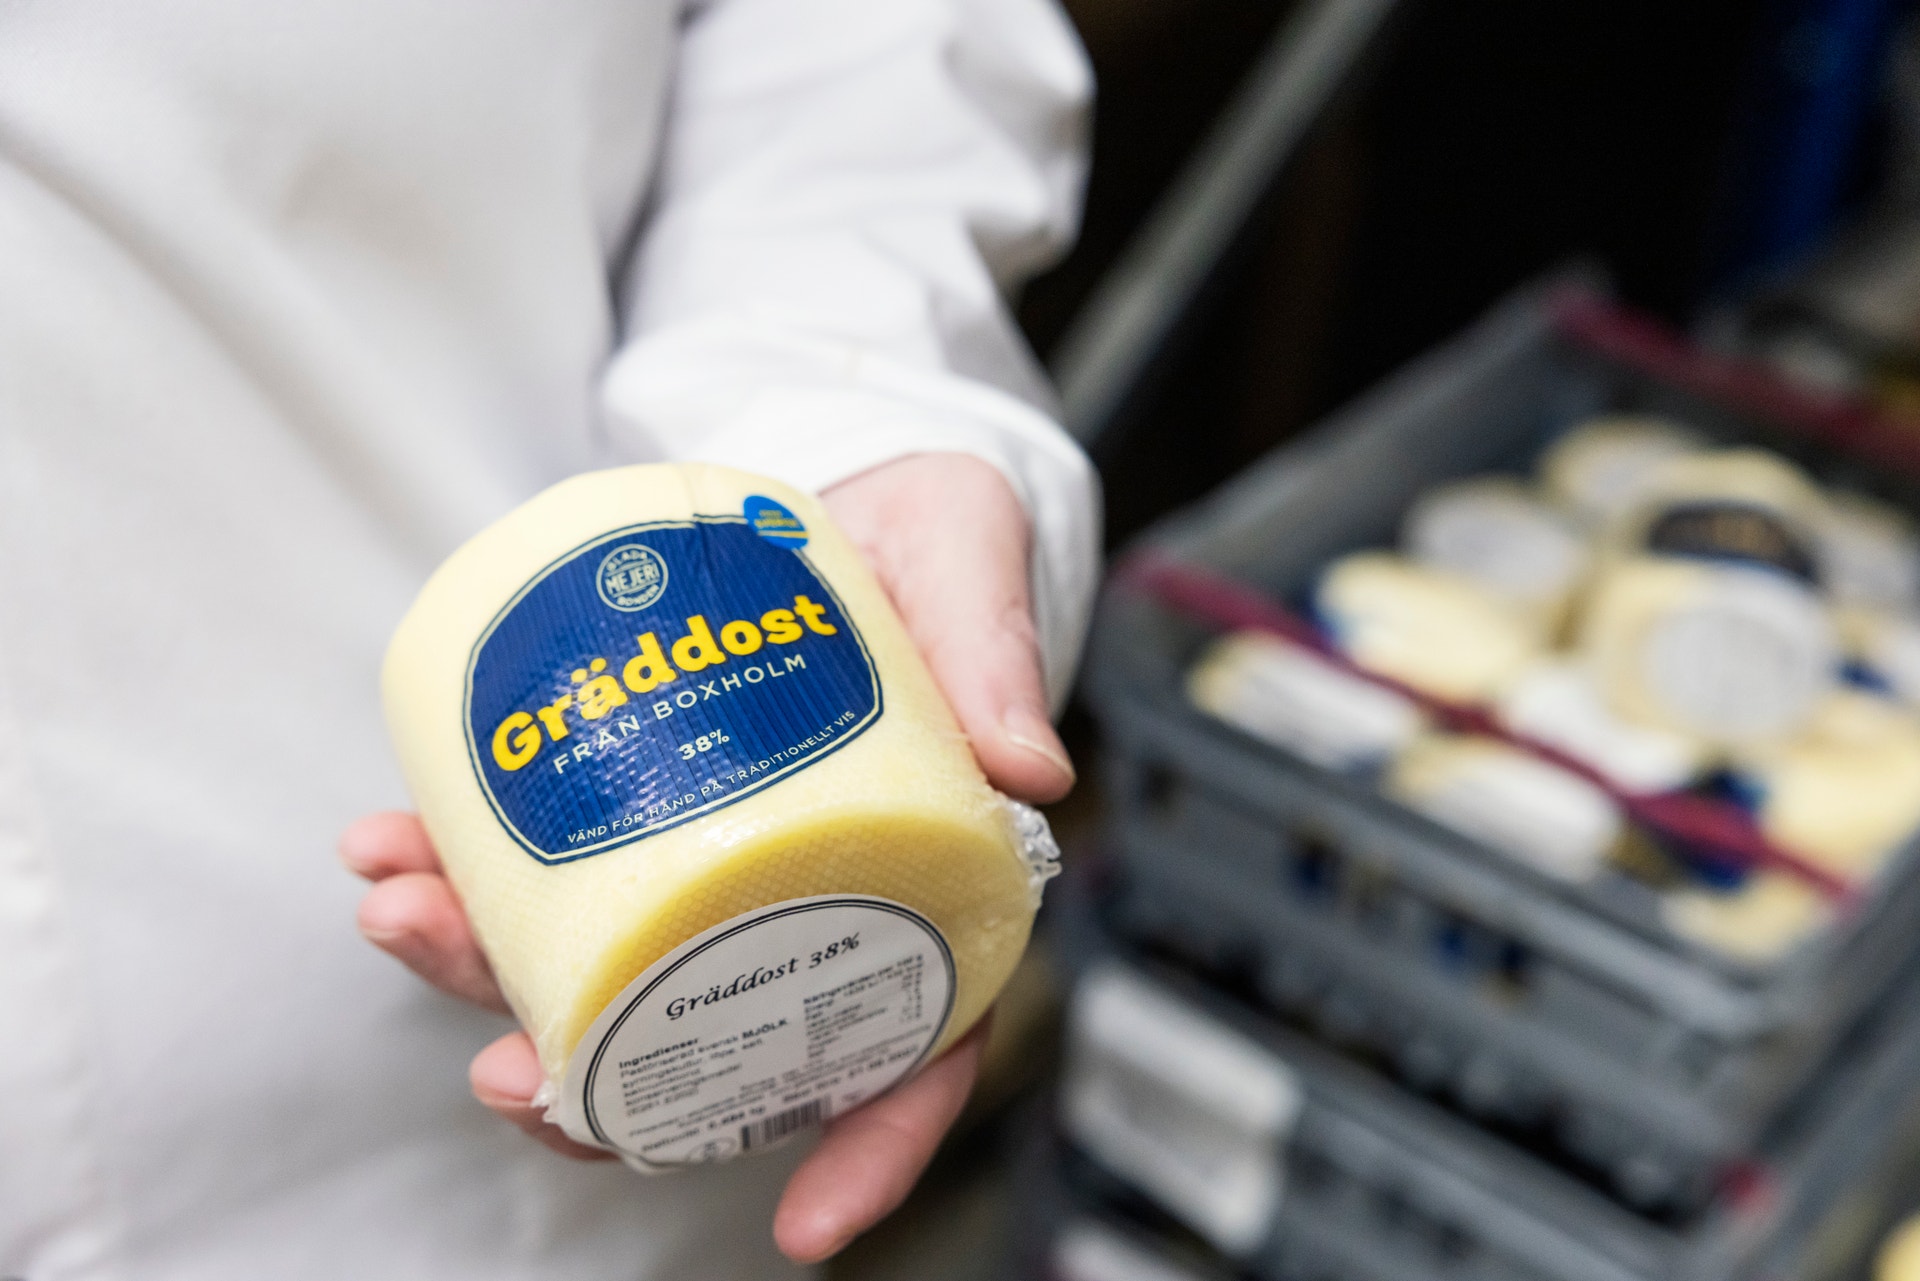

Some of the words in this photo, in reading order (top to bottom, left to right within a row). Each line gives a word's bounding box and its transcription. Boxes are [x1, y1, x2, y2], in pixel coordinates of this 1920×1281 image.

[605, 562, 661, 597] MEJERI
[491, 594, 838, 772] Gräddost
[552, 713, 642, 775] FRÅN
[652, 653, 807, 721] BOXHOLM
[566, 825, 608, 845] VÄND
[611, 813, 644, 832] FÖR
[700, 779, 724, 797] PÅ
[725, 725, 836, 784] TRADITIONELLT
[833, 710, 856, 727] VIS
[678, 728, 731, 761] 38%
[665, 957, 799, 1021] Gräddost
[808, 931, 861, 970] 38%
